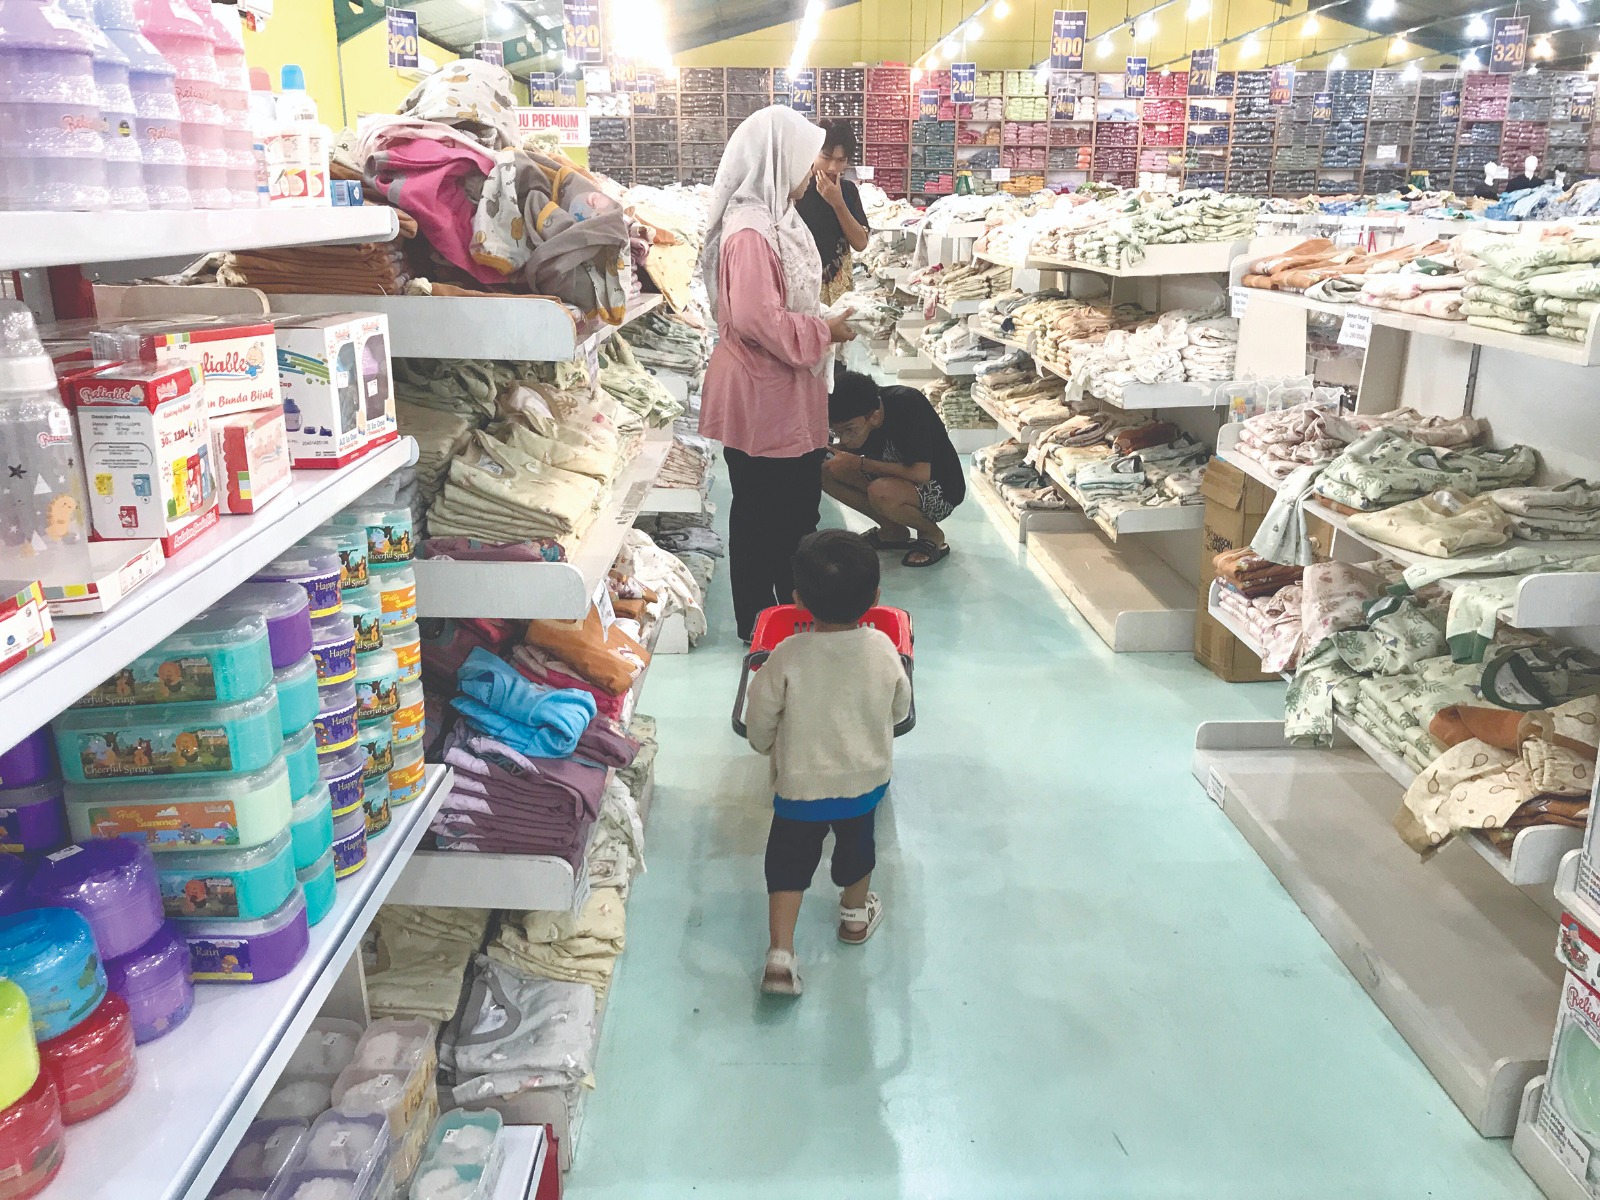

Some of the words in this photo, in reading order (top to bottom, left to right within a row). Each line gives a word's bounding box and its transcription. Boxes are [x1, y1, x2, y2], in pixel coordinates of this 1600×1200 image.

[564, 24, 600, 48] 320
[388, 32, 417, 56] 320
[1053, 36, 1083, 56] 300
[1493, 42, 1525, 62] 320
[952, 80, 974, 93] 240
[1127, 73, 1145, 89] 240
[793, 89, 812, 103] 270
[920, 103, 937, 115] 300
[1313, 106, 1331, 118] 220
[531, 113, 580, 128] PREMIUM
[200, 351, 248, 373] liable
[217, 394, 249, 408] Bunda
[250, 387, 274, 402] Bijak
[315, 581, 337, 591] Happy
[329, 648, 351, 658] Happy
[77, 695, 103, 705] eerful
[105, 694, 136, 705] Spring
[332, 713, 352, 725] Happy
[84, 763, 122, 776] Cheerful
[123, 763, 154, 775] Spring
[338, 779, 358, 791] Happy
[116, 809, 141, 820] Hello
[135, 818, 182, 828] Summer
[195, 946, 220, 957] Rain
